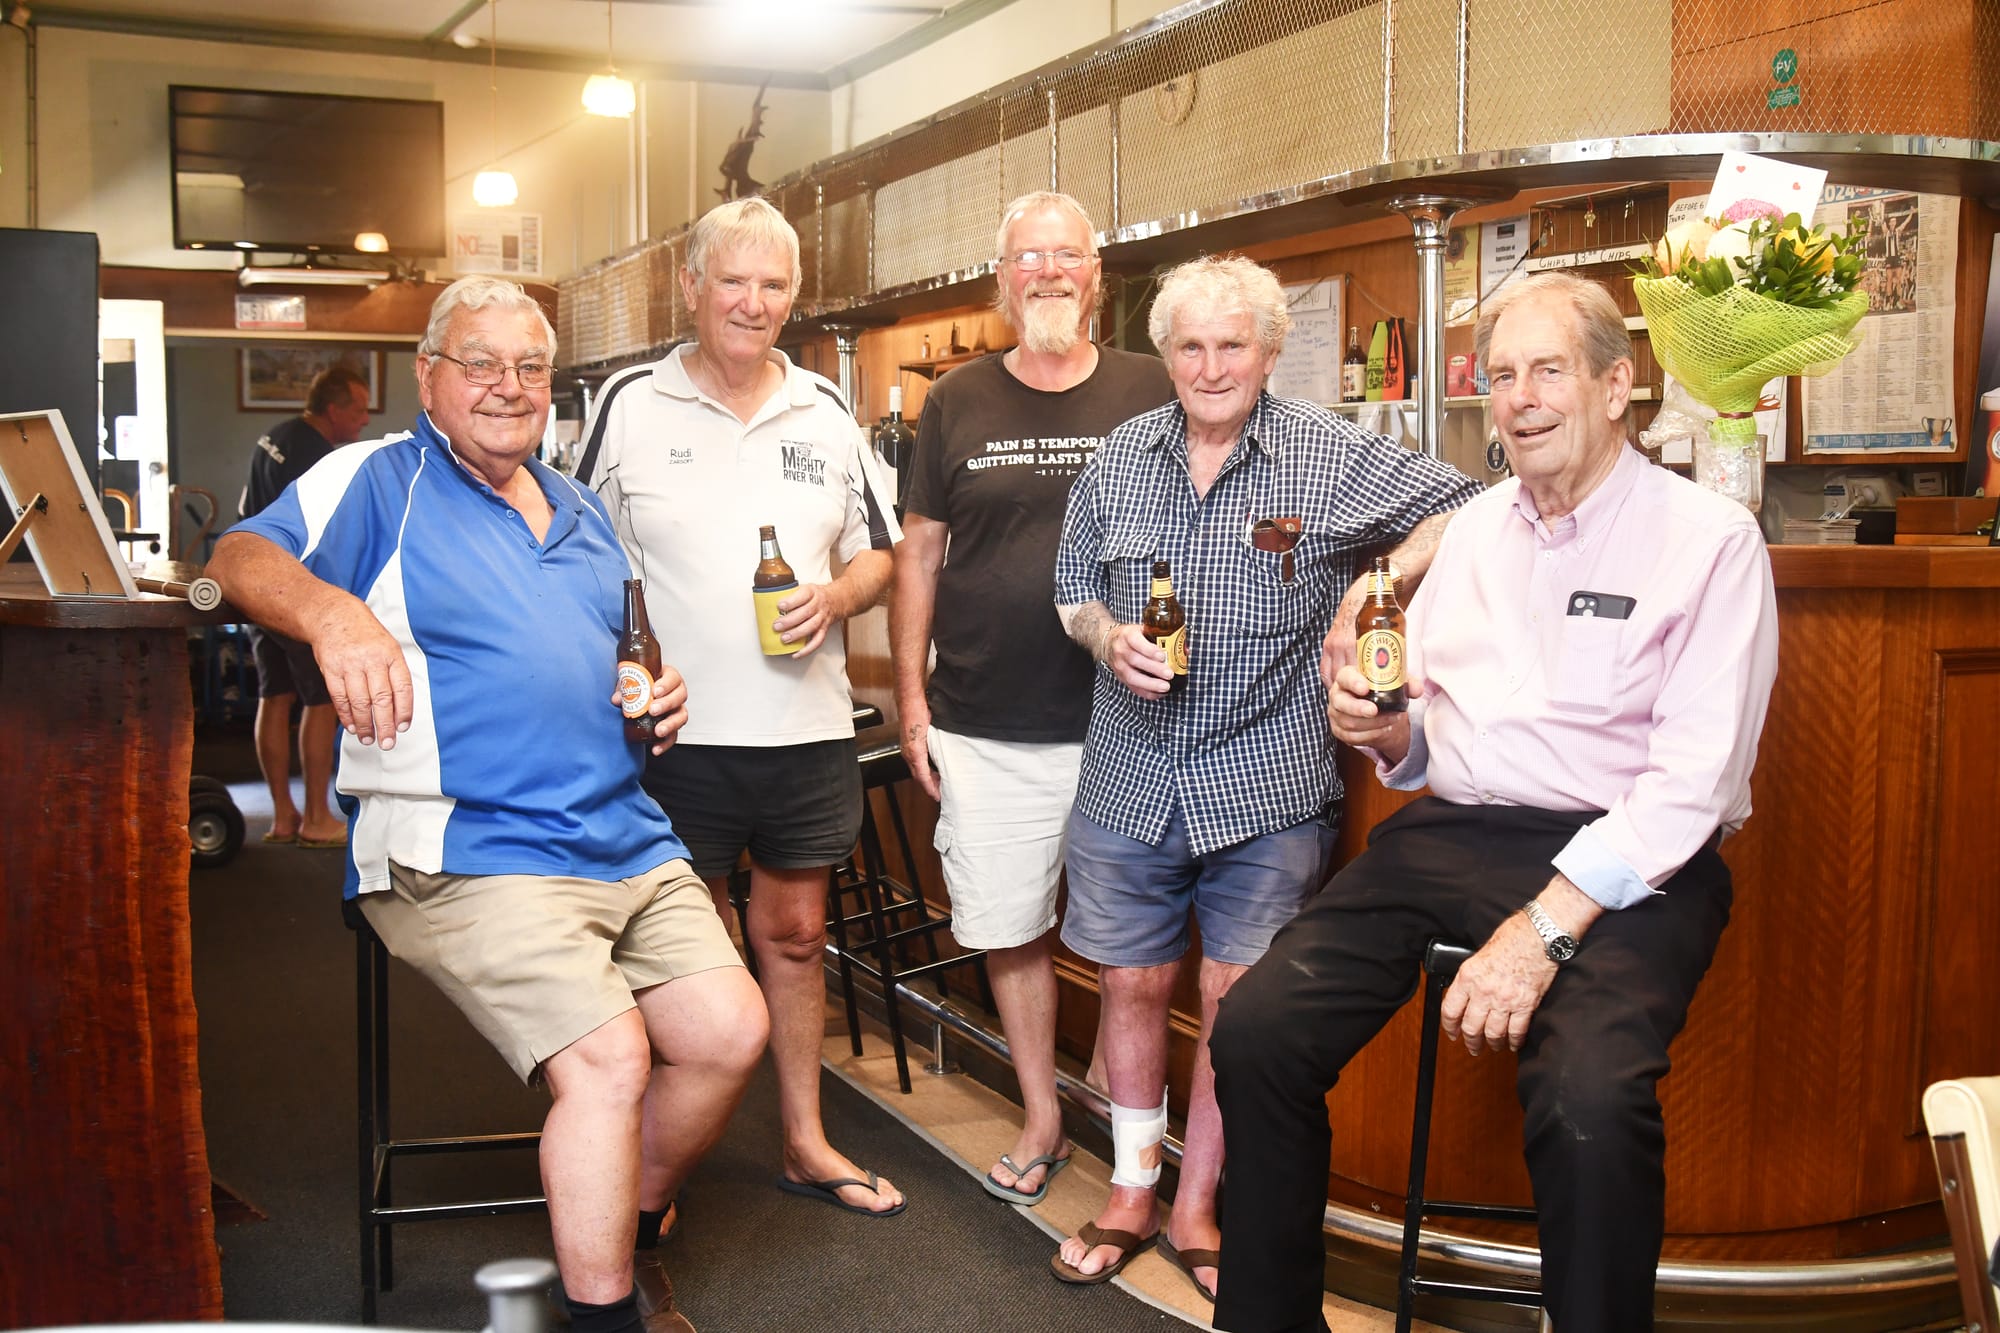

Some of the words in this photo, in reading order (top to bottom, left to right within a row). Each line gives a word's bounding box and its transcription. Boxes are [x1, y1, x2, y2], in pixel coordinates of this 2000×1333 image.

[1776, 59, 1793, 74] PV
[1675, 202, 1698, 212] BEFORE
[456, 233, 480, 256] NO
[1539, 257, 1567, 269] CHIPS
[1600, 250, 1632, 263] CHIPS
[670, 448, 692, 458] Rudi
[986, 439, 1019, 452] PAIN
[1022, 438, 1036, 450] IS
[781, 446, 826, 474] MIGHTY
[967, 454, 1035, 470] QUITTING
[1038, 452, 1082, 464] LASTS
[783, 469, 806, 483] RIVER
[809, 473, 825, 487] RUN
[1365, 636, 1400, 663] SOUTHWARK
